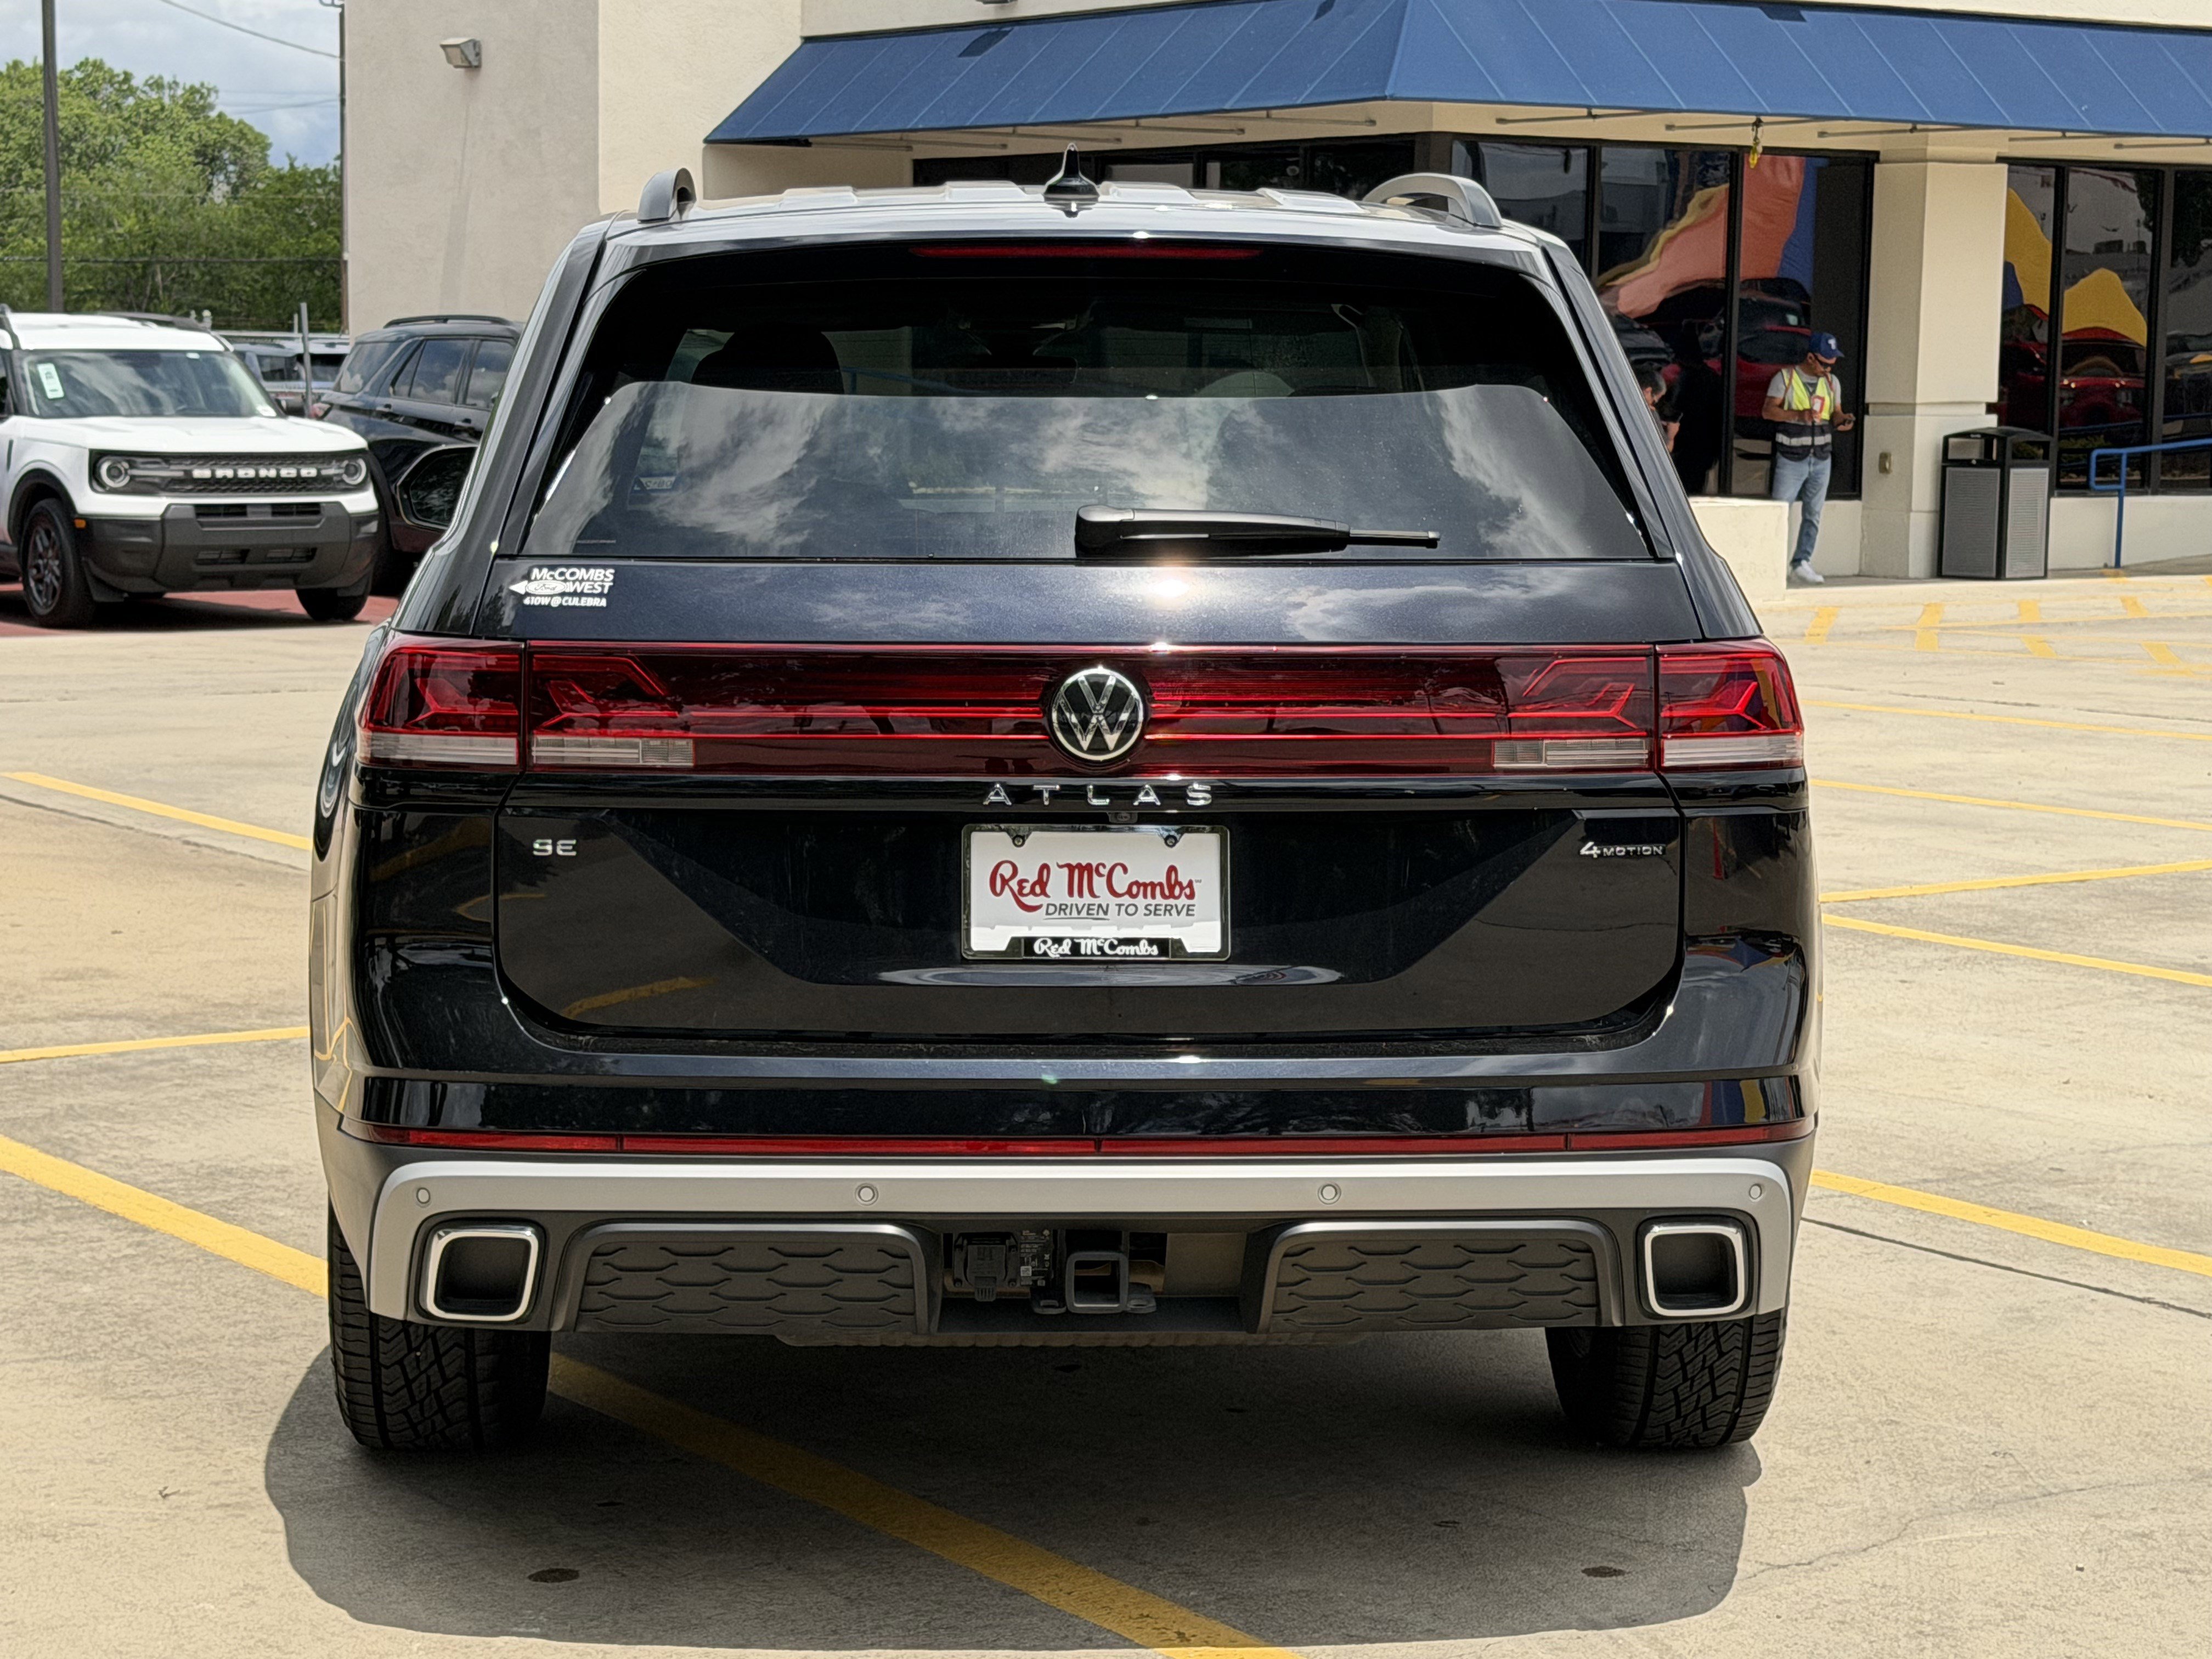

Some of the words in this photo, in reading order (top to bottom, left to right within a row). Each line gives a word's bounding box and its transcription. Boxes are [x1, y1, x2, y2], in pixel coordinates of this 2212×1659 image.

[193, 467, 317, 478] BRONCO
[531, 567, 615, 582] McCOMBS
[566, 582, 613, 594] WEST
[983, 784, 1212, 806] ATLAS
[533, 839, 577, 856] SE
[1579, 841, 1663, 859] 4MOTION
[989, 859, 1051, 913] Red
[1056, 861, 1195, 900] McCombs
[1045, 903, 1109, 916] DRIVEN
[1115, 903, 1138, 916] TO
[1143, 903, 1196, 917] SERVE
[1034, 938, 1071, 958] Red
[1074, 938, 1158, 955] McCombs
